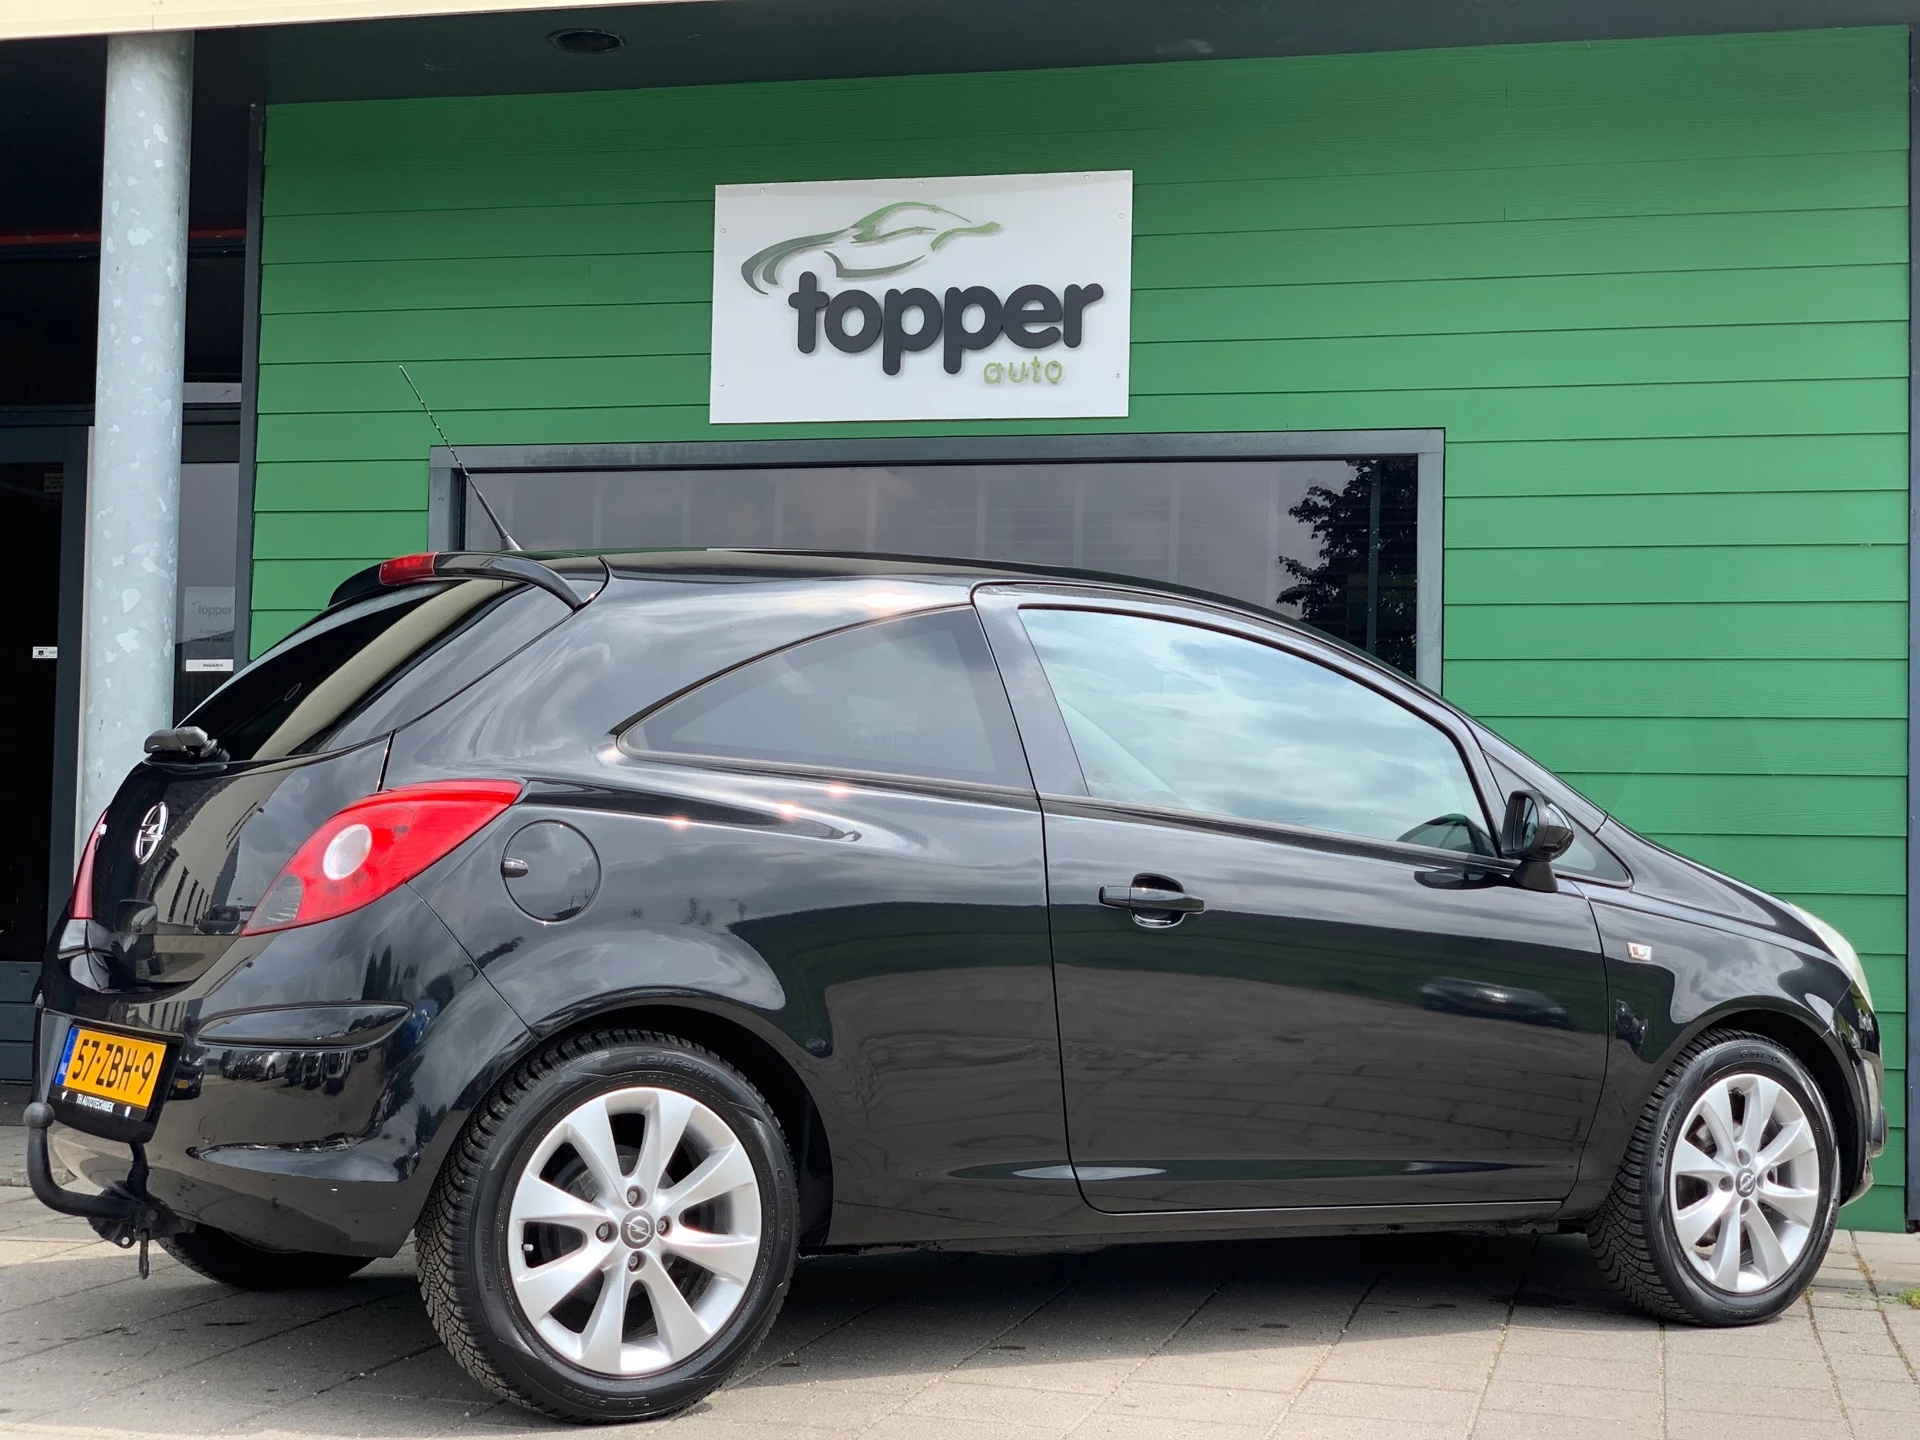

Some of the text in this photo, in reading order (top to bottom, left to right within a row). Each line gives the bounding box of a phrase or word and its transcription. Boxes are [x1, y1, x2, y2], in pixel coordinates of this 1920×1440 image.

[788, 271, 1104, 375] topper
[983, 355, 1063, 384] auto
[198, 604, 233, 618] topper
[72, 1038, 155, 1095] 57-ZBH-9
